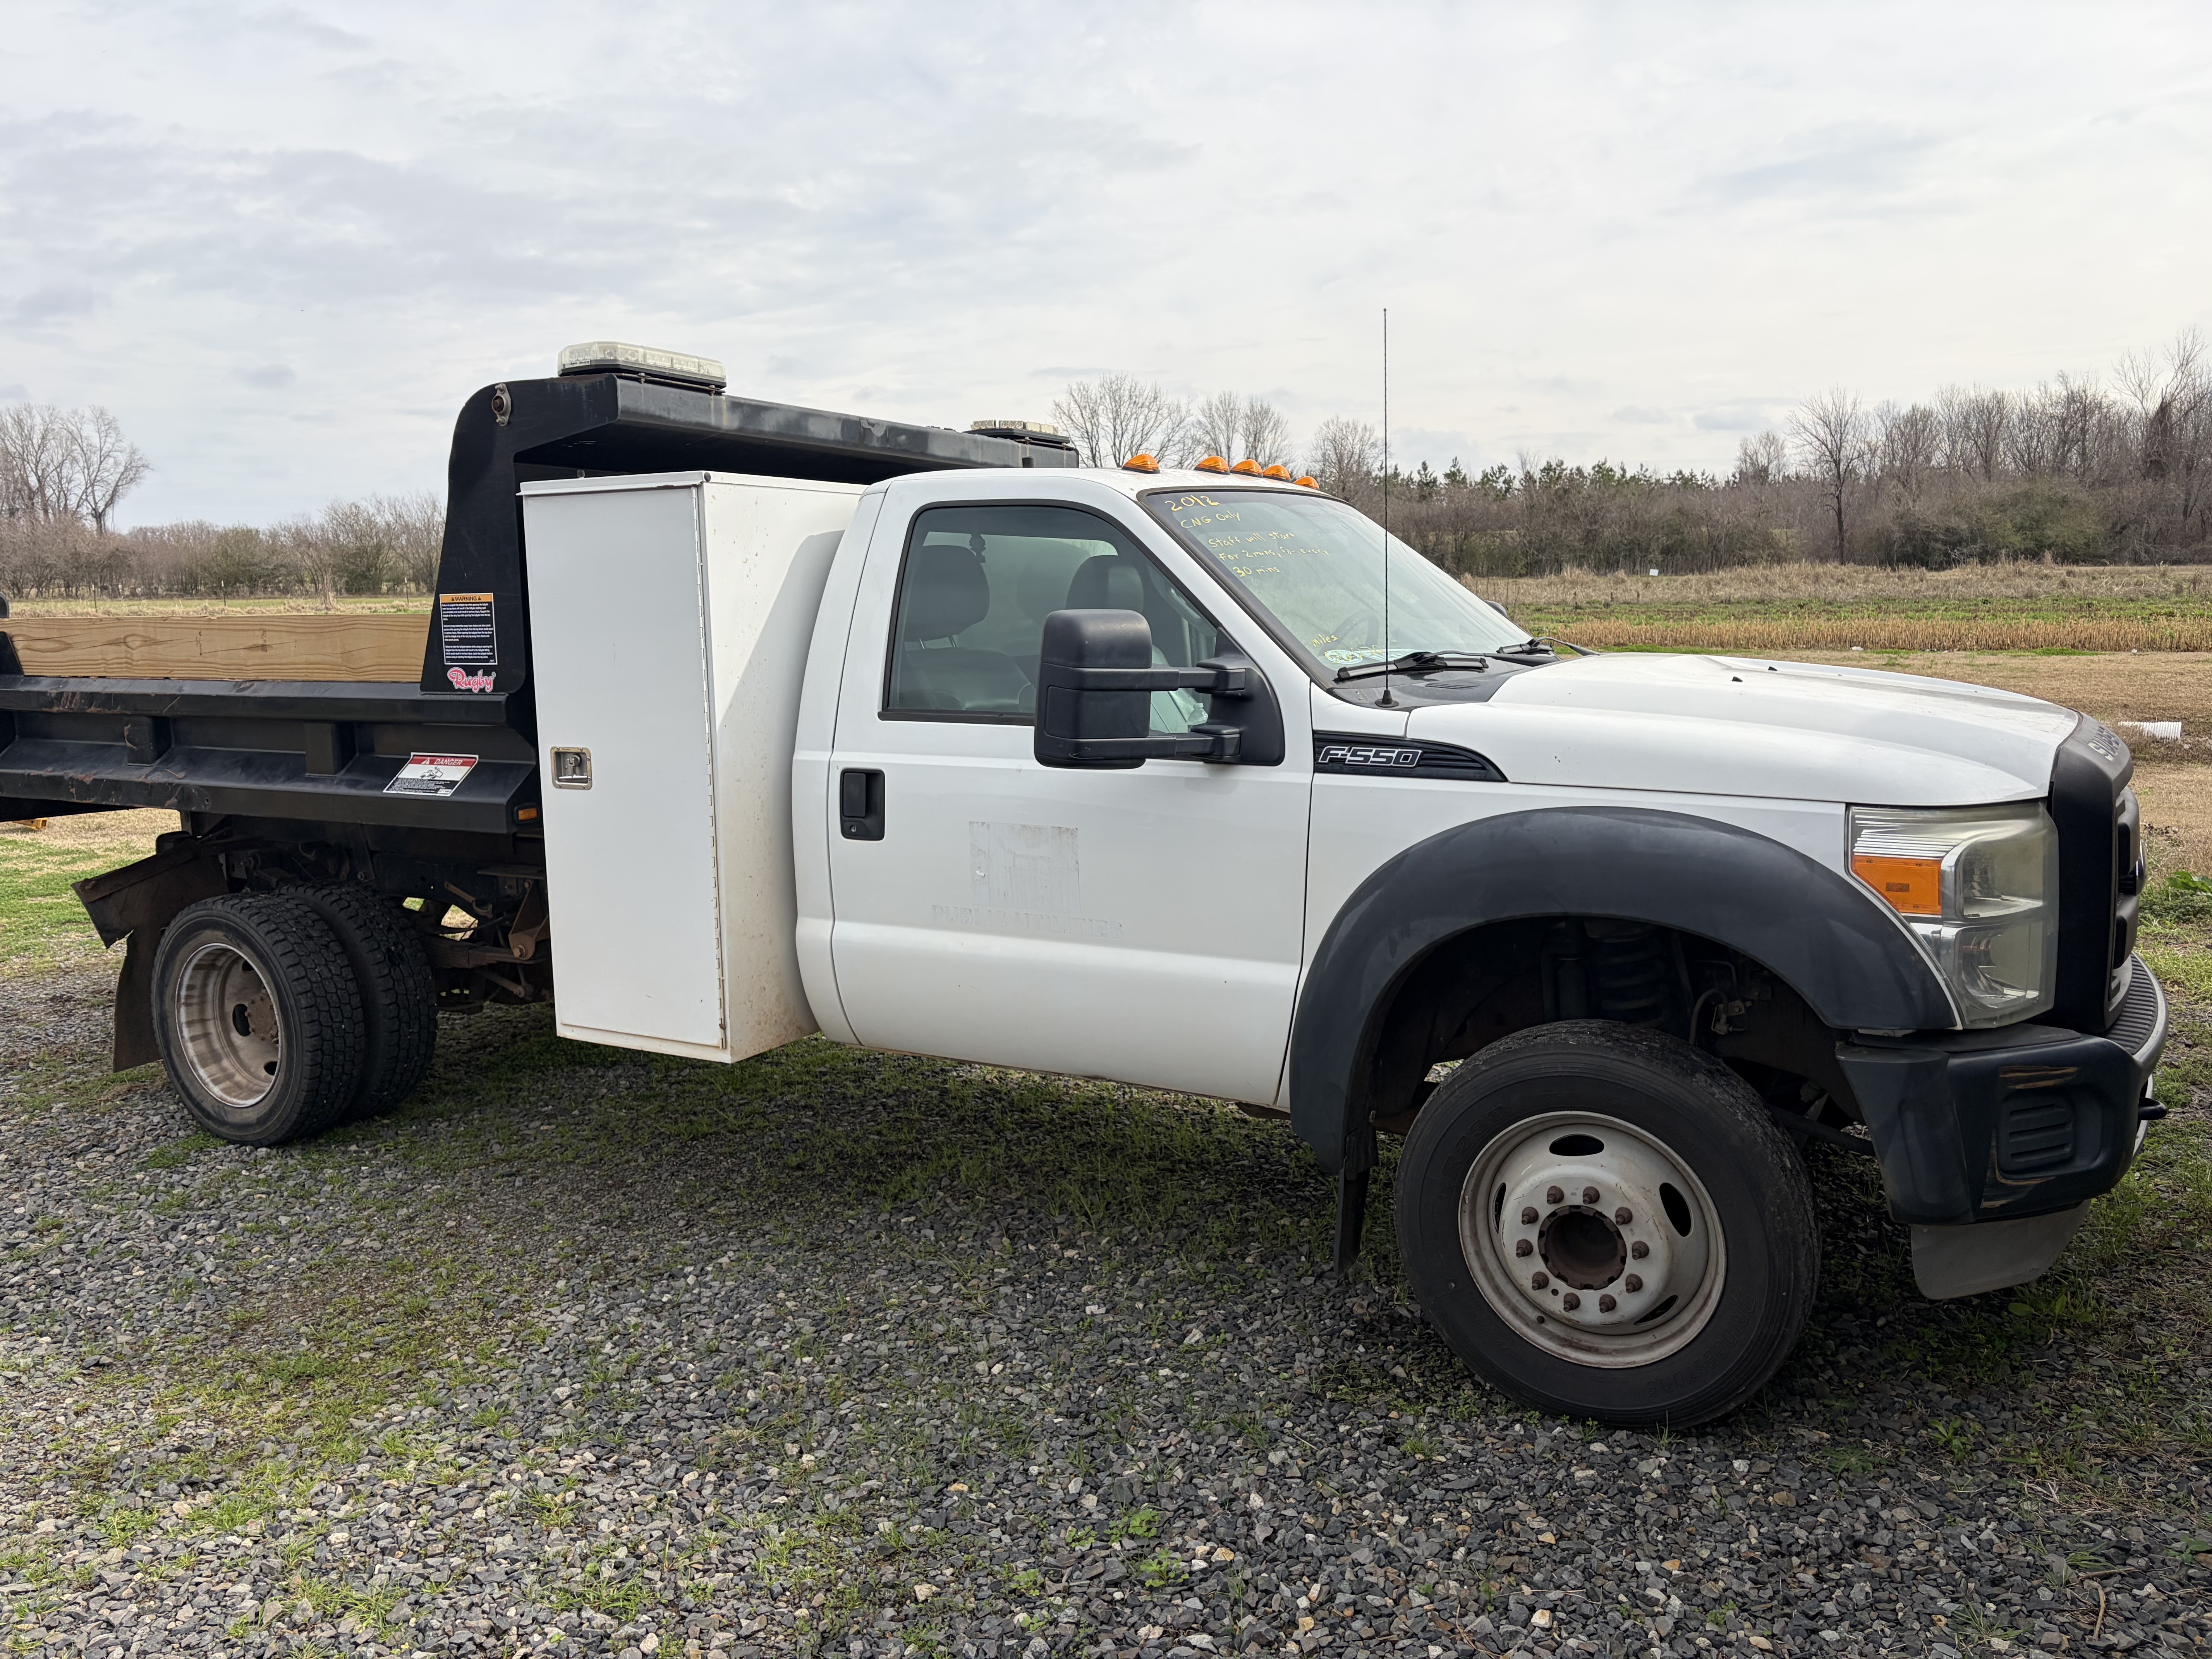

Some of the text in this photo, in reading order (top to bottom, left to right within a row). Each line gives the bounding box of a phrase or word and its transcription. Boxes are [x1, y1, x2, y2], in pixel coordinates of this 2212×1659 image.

[1165, 495, 1220, 512] 2012
[1180, 511, 1241, 529] CNG Only
[1208, 536, 1241, 548] Staff
[1246, 533, 1266, 543] will
[1300, 548, 1330, 556] every
[1233, 566, 1252, 577] 30
[1311, 634, 1338, 647] Miles
[447, 667, 493, 693] Rugby
[1317, 746, 1424, 767] F-550
[931, 904, 1123, 939] PUBLIC UTILITIES
[1647, 1286, 1756, 1398] BRIDGESTONE
